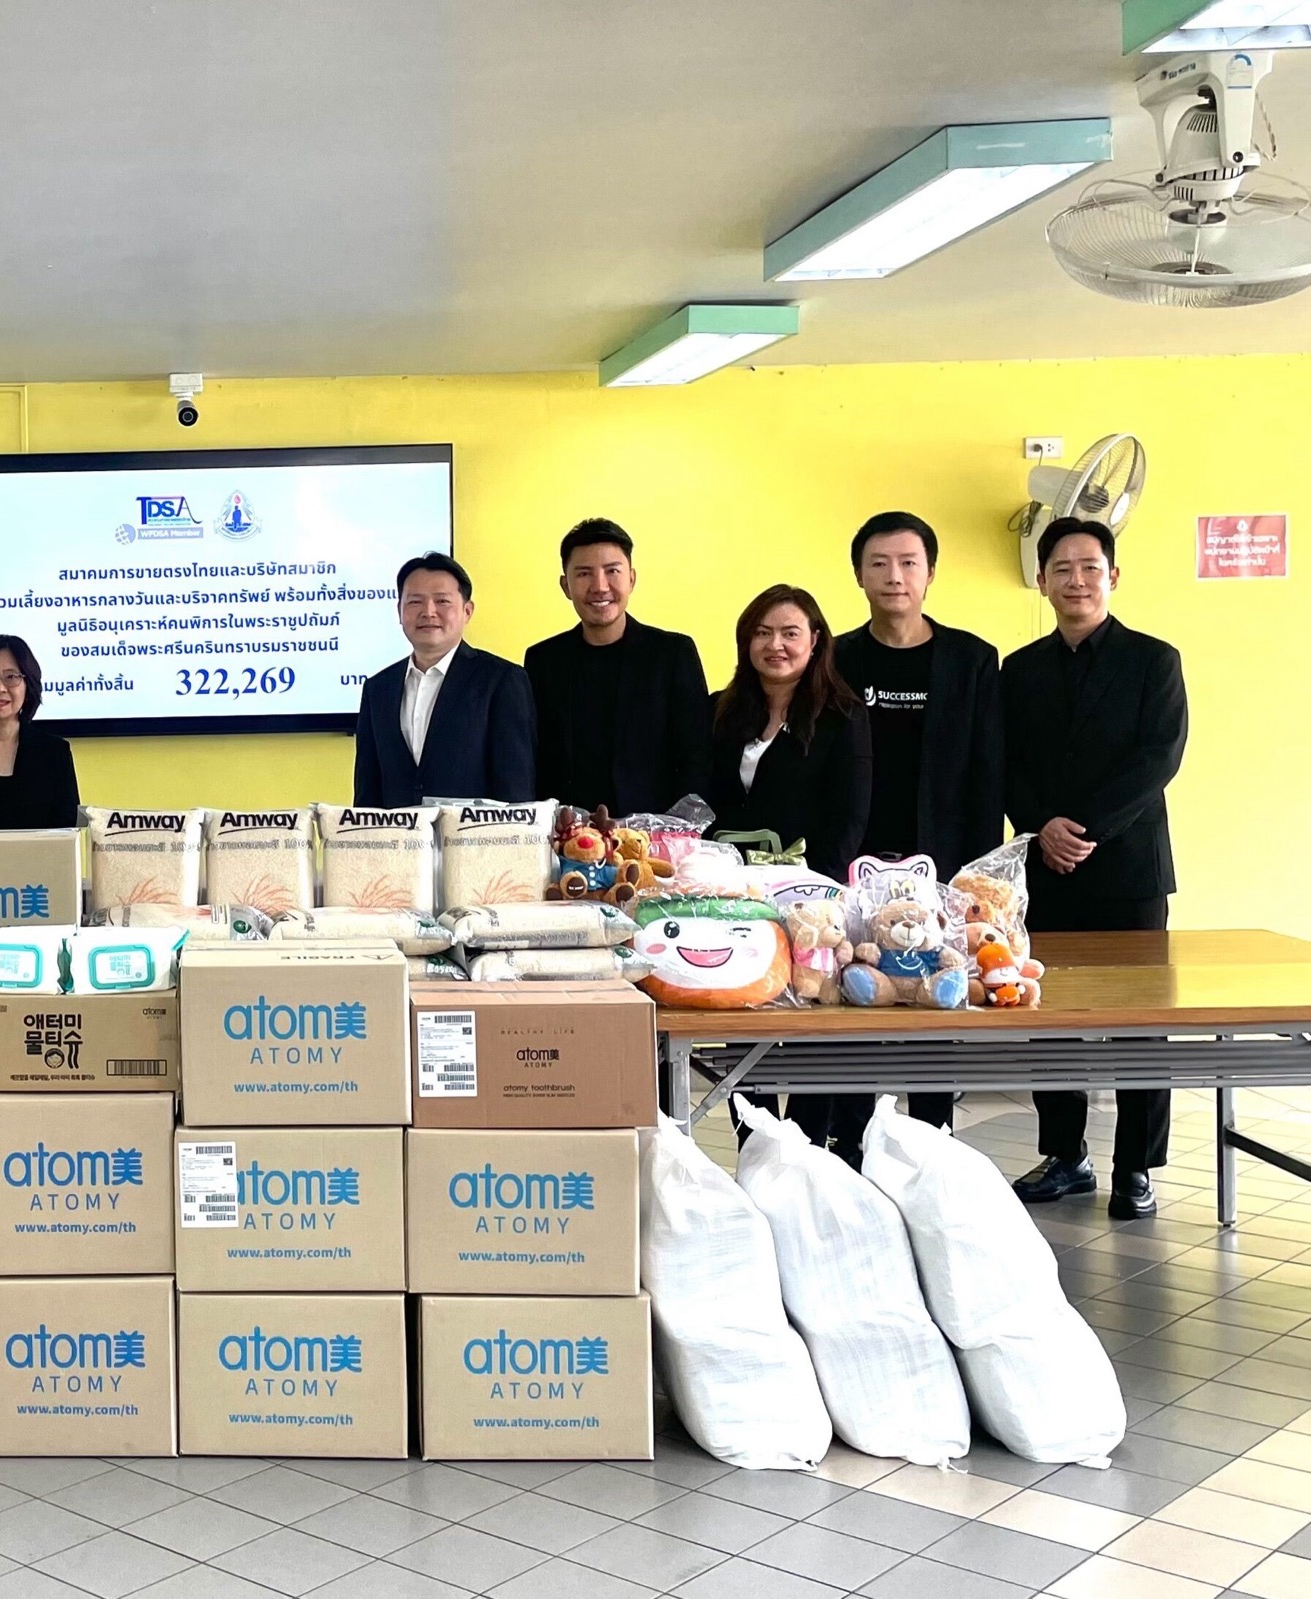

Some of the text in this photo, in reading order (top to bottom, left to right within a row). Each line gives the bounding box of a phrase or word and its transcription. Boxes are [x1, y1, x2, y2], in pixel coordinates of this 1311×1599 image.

[136, 496, 203, 524] TDSA
[171, 529, 200, 537] Member
[58, 561, 337, 581] สมาคมการขายตรงไทยและบริษัทสมาชิก
[275, 583, 398, 602] พร้อมทั้งสิ่งของแ
[57, 612, 340, 636] มูลนิธิอนุเคราะห์คนพิการในพระราชูปถัมภ์
[61, 637, 339, 657] ของสมเด็จพระศรีนครินทราบรมราชชนนี
[42, 666, 368, 700] มมูลค่าทั้งสิ้น 322,269 บาท
[107, 812, 185, 832] Amway
[220, 812, 298, 830] Amway
[339, 809, 418, 830] Amway
[460, 807, 536, 824] Amway
[24, 1014, 81, 1029] 애터미
[224, 996, 367, 1040] atom美
[25, 1031, 83, 1068] 물티슈
[250, 1047, 342, 1064] ATOMY
[234, 1081, 357, 1094] www.atomy.com/th
[4, 1142, 143, 1186] atom美
[237, 1161, 359, 1206] tom美
[449, 1164, 594, 1210] atom美
[30, 1193, 119, 1210] ATOMY
[15, 1222, 136, 1235] www.atomy.com/th
[243, 1213, 335, 1230] ATOMY
[475, 1217, 569, 1233] ATOMY
[227, 1247, 351, 1260] www.atomy.com/th
[459, 1251, 584, 1265] www.atomy.com/th
[6, 1325, 145, 1368] atom美
[219, 1327, 362, 1373] atom美
[463, 1329, 609, 1375] atom美
[32, 1375, 122, 1393] ATOMY
[245, 1379, 337, 1396] ATOMY
[490, 1382, 584, 1399] ATOMY
[17, 1403, 138, 1416] www.atomy.com/th
[229, 1414, 353, 1427] www.atomy.com/th
[473, 1416, 599, 1429] www.atomy.com/th
